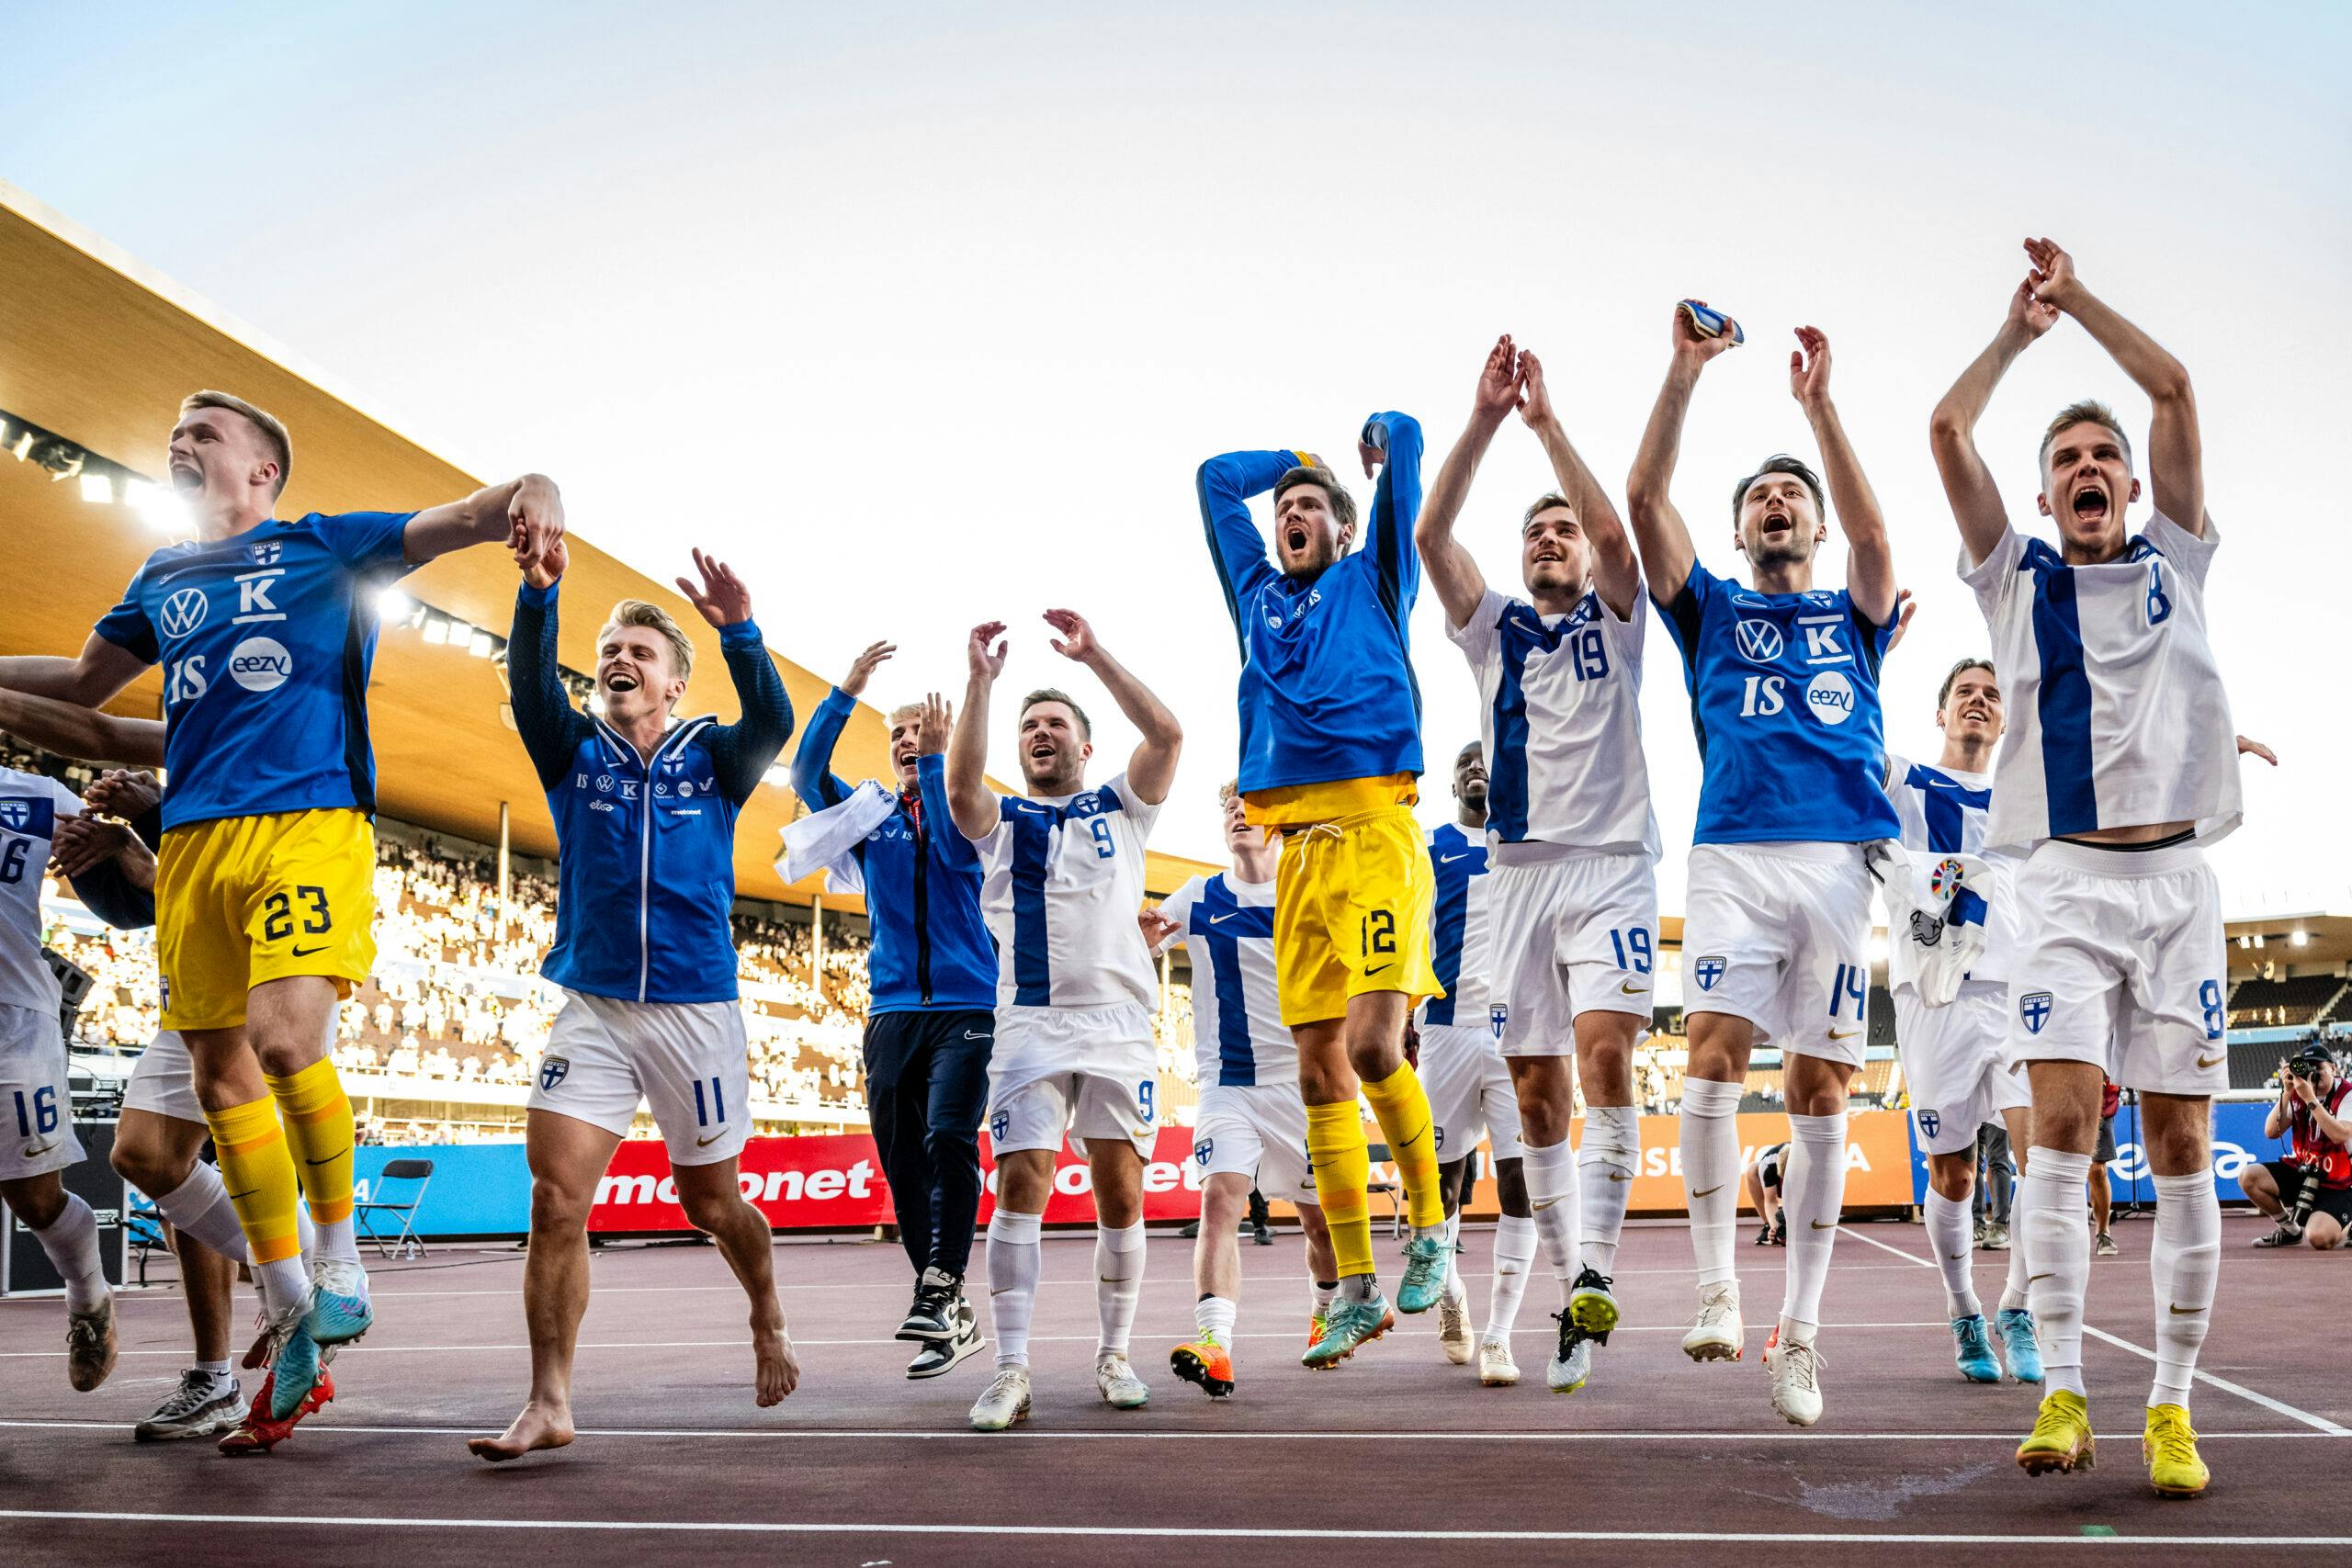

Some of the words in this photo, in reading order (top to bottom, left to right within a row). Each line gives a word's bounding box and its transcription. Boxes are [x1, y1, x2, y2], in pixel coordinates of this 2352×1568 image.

[241, 579, 277, 613] K
[2147, 562, 2172, 626] 8
[1570, 629, 1610, 682] 19
[1805, 625, 1843, 657] K
[169, 655, 208, 705] IS
[232, 655, 291, 677] eezy
[1739, 676, 1786, 717] IS
[1809, 689, 1853, 713] eezy
[576, 773, 589, 789] IS
[0, 832, 31, 885] 6
[1090, 818, 1116, 859] 9
[264, 885, 333, 942] 23
[1362, 909, 1396, 958] 12
[1611, 927, 1653, 975] 19
[1829, 964, 1866, 1021] 14
[2199, 978, 2224, 1040] 8
[14, 1085, 59, 1137] 16
[693, 1077, 725, 1127] 11
[1139, 1080, 1154, 1122] 9
[593, 1159, 875, 1205] moonet
